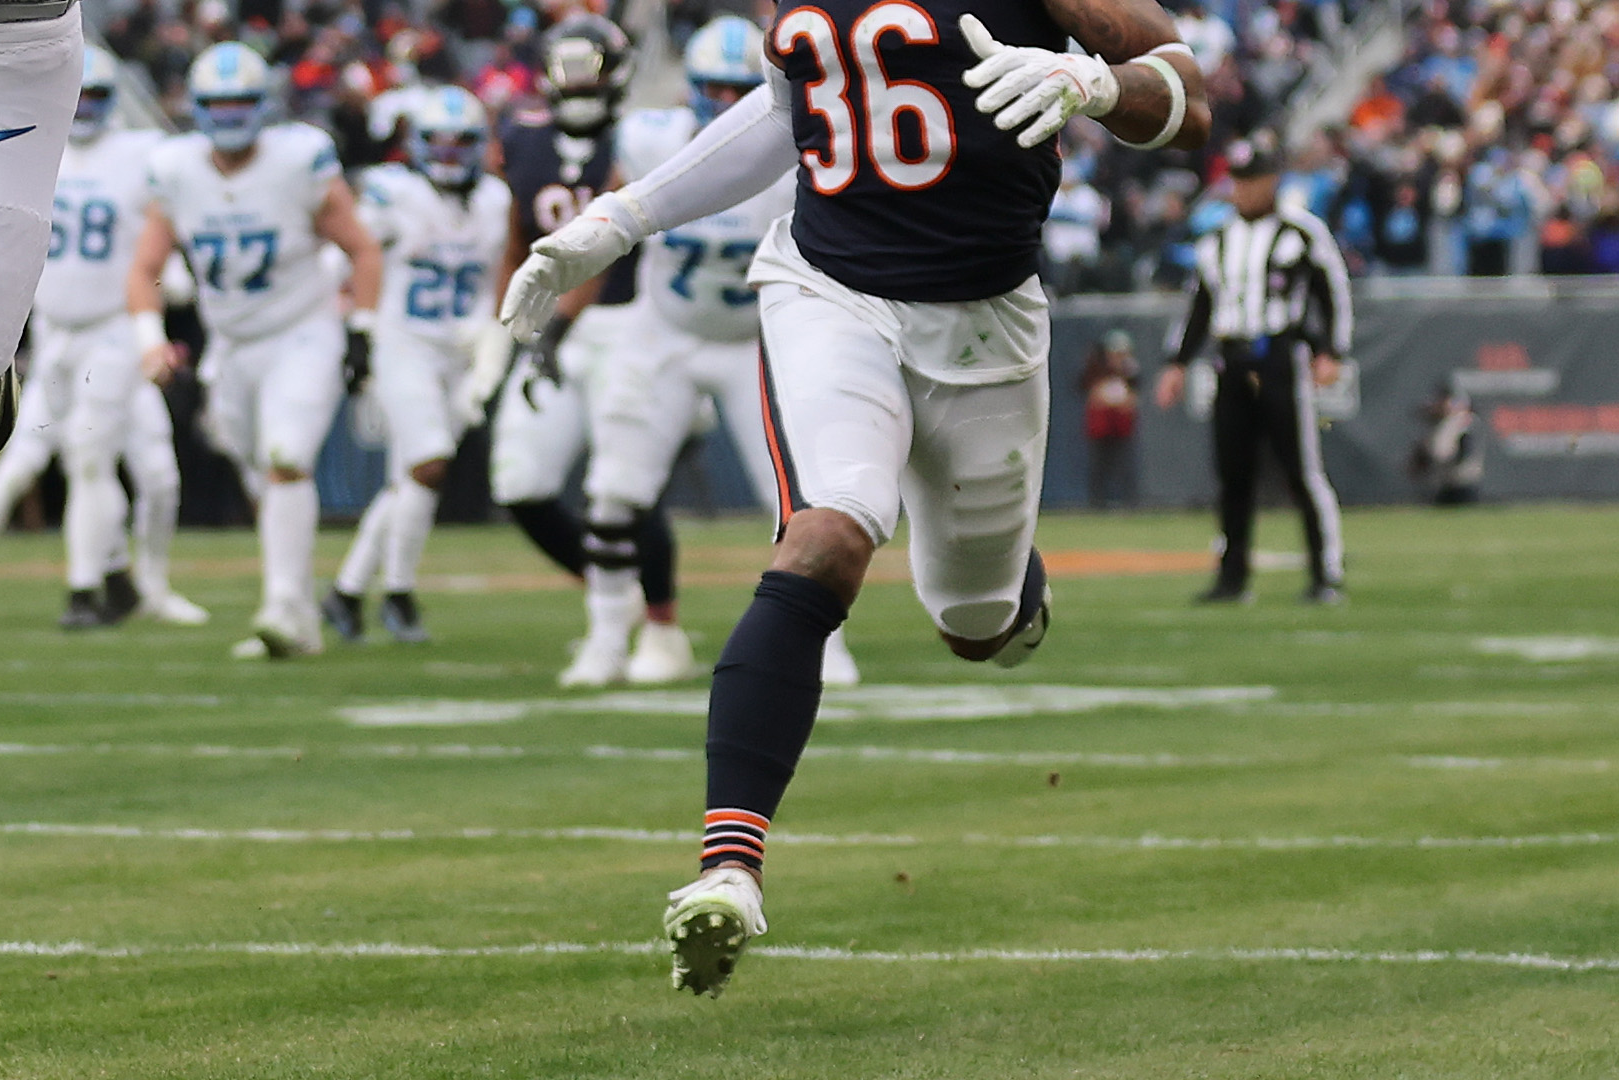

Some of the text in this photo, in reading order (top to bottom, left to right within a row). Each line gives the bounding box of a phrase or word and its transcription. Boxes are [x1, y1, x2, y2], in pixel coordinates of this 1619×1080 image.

[192, 228, 279, 292] 77
[406, 258, 486, 320] 26
[664, 231, 759, 307] 73
